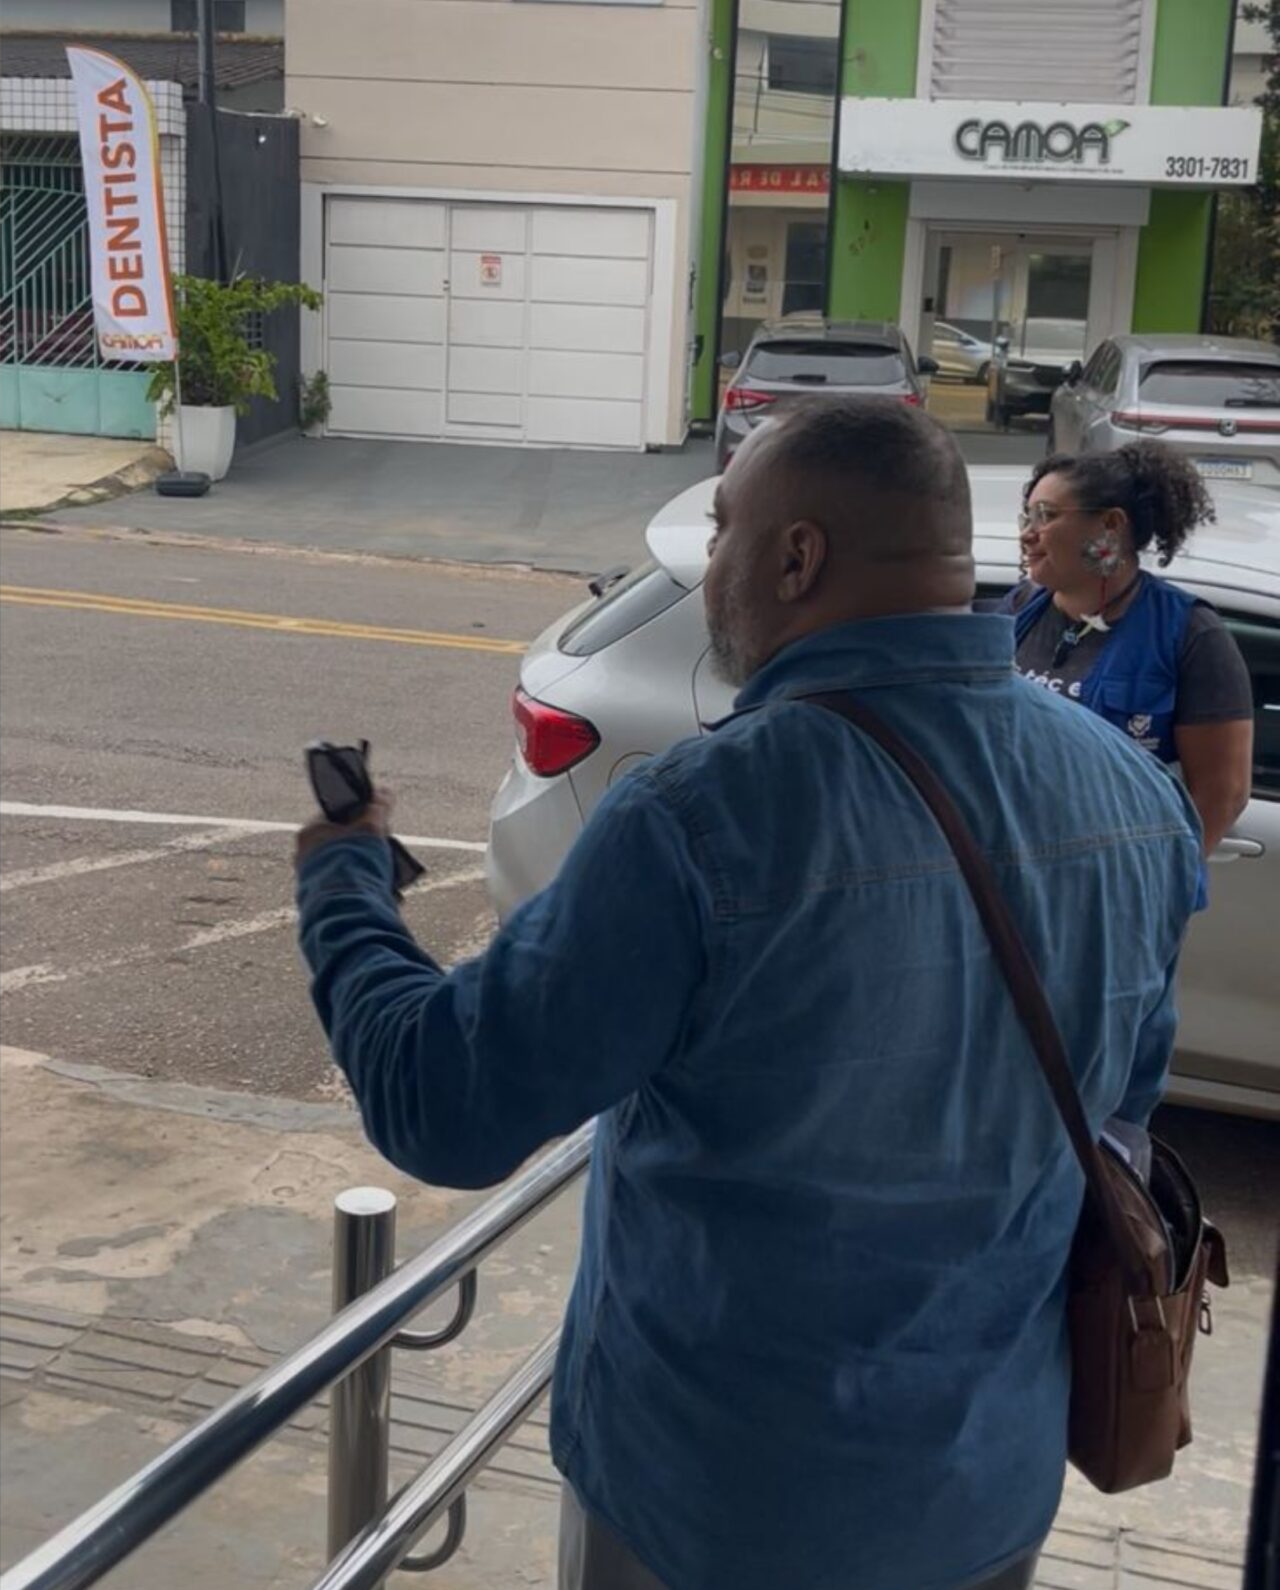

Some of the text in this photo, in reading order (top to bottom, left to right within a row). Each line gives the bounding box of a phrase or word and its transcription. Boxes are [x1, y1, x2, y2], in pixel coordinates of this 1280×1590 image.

[954, 119, 1109, 164] CAMOA
[1165, 156, 1248, 179] 3301-7831
[97, 78, 148, 318] DENTISTA
